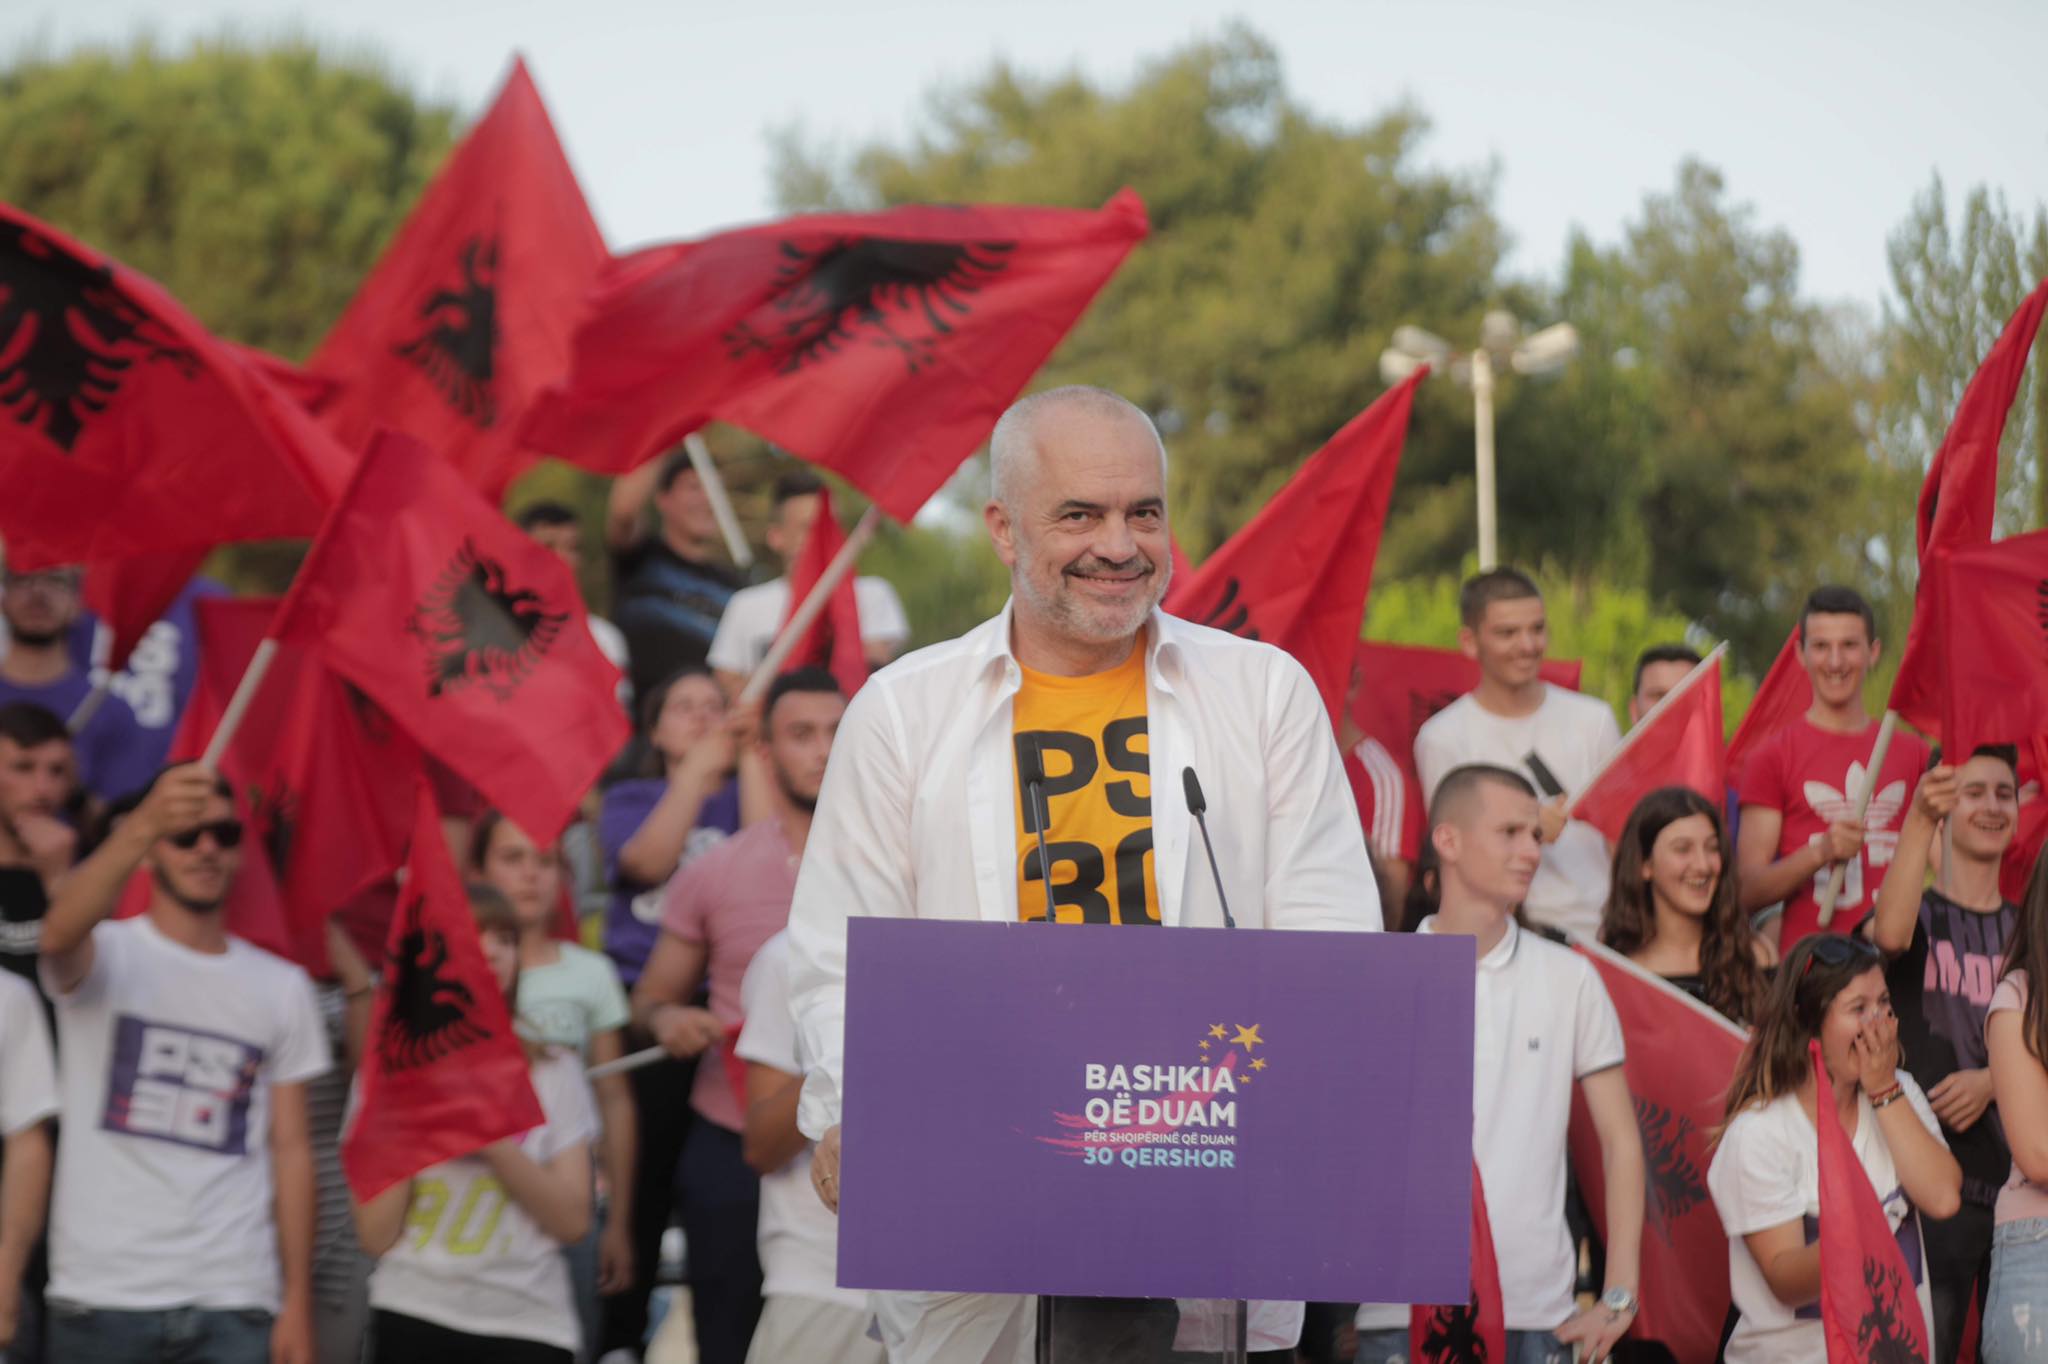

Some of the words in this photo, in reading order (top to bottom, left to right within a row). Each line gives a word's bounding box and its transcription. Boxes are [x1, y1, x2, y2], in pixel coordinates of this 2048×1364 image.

[1014, 716, 1151, 833] PS
[1085, 1063, 1236, 1093] BASHKIA
[1085, 1093, 1133, 1128] QË
[1138, 1099, 1236, 1128] DUAM
[1084, 1131, 1108, 1143] PËR
[1110, 1131, 1180, 1145] SHQIPËRINË
[1181, 1133, 1198, 1147] QË
[1200, 1134, 1235, 1146] DUAM
[1083, 1147, 1114, 1165] 30
[1120, 1148, 1235, 1168] QERSHOR
